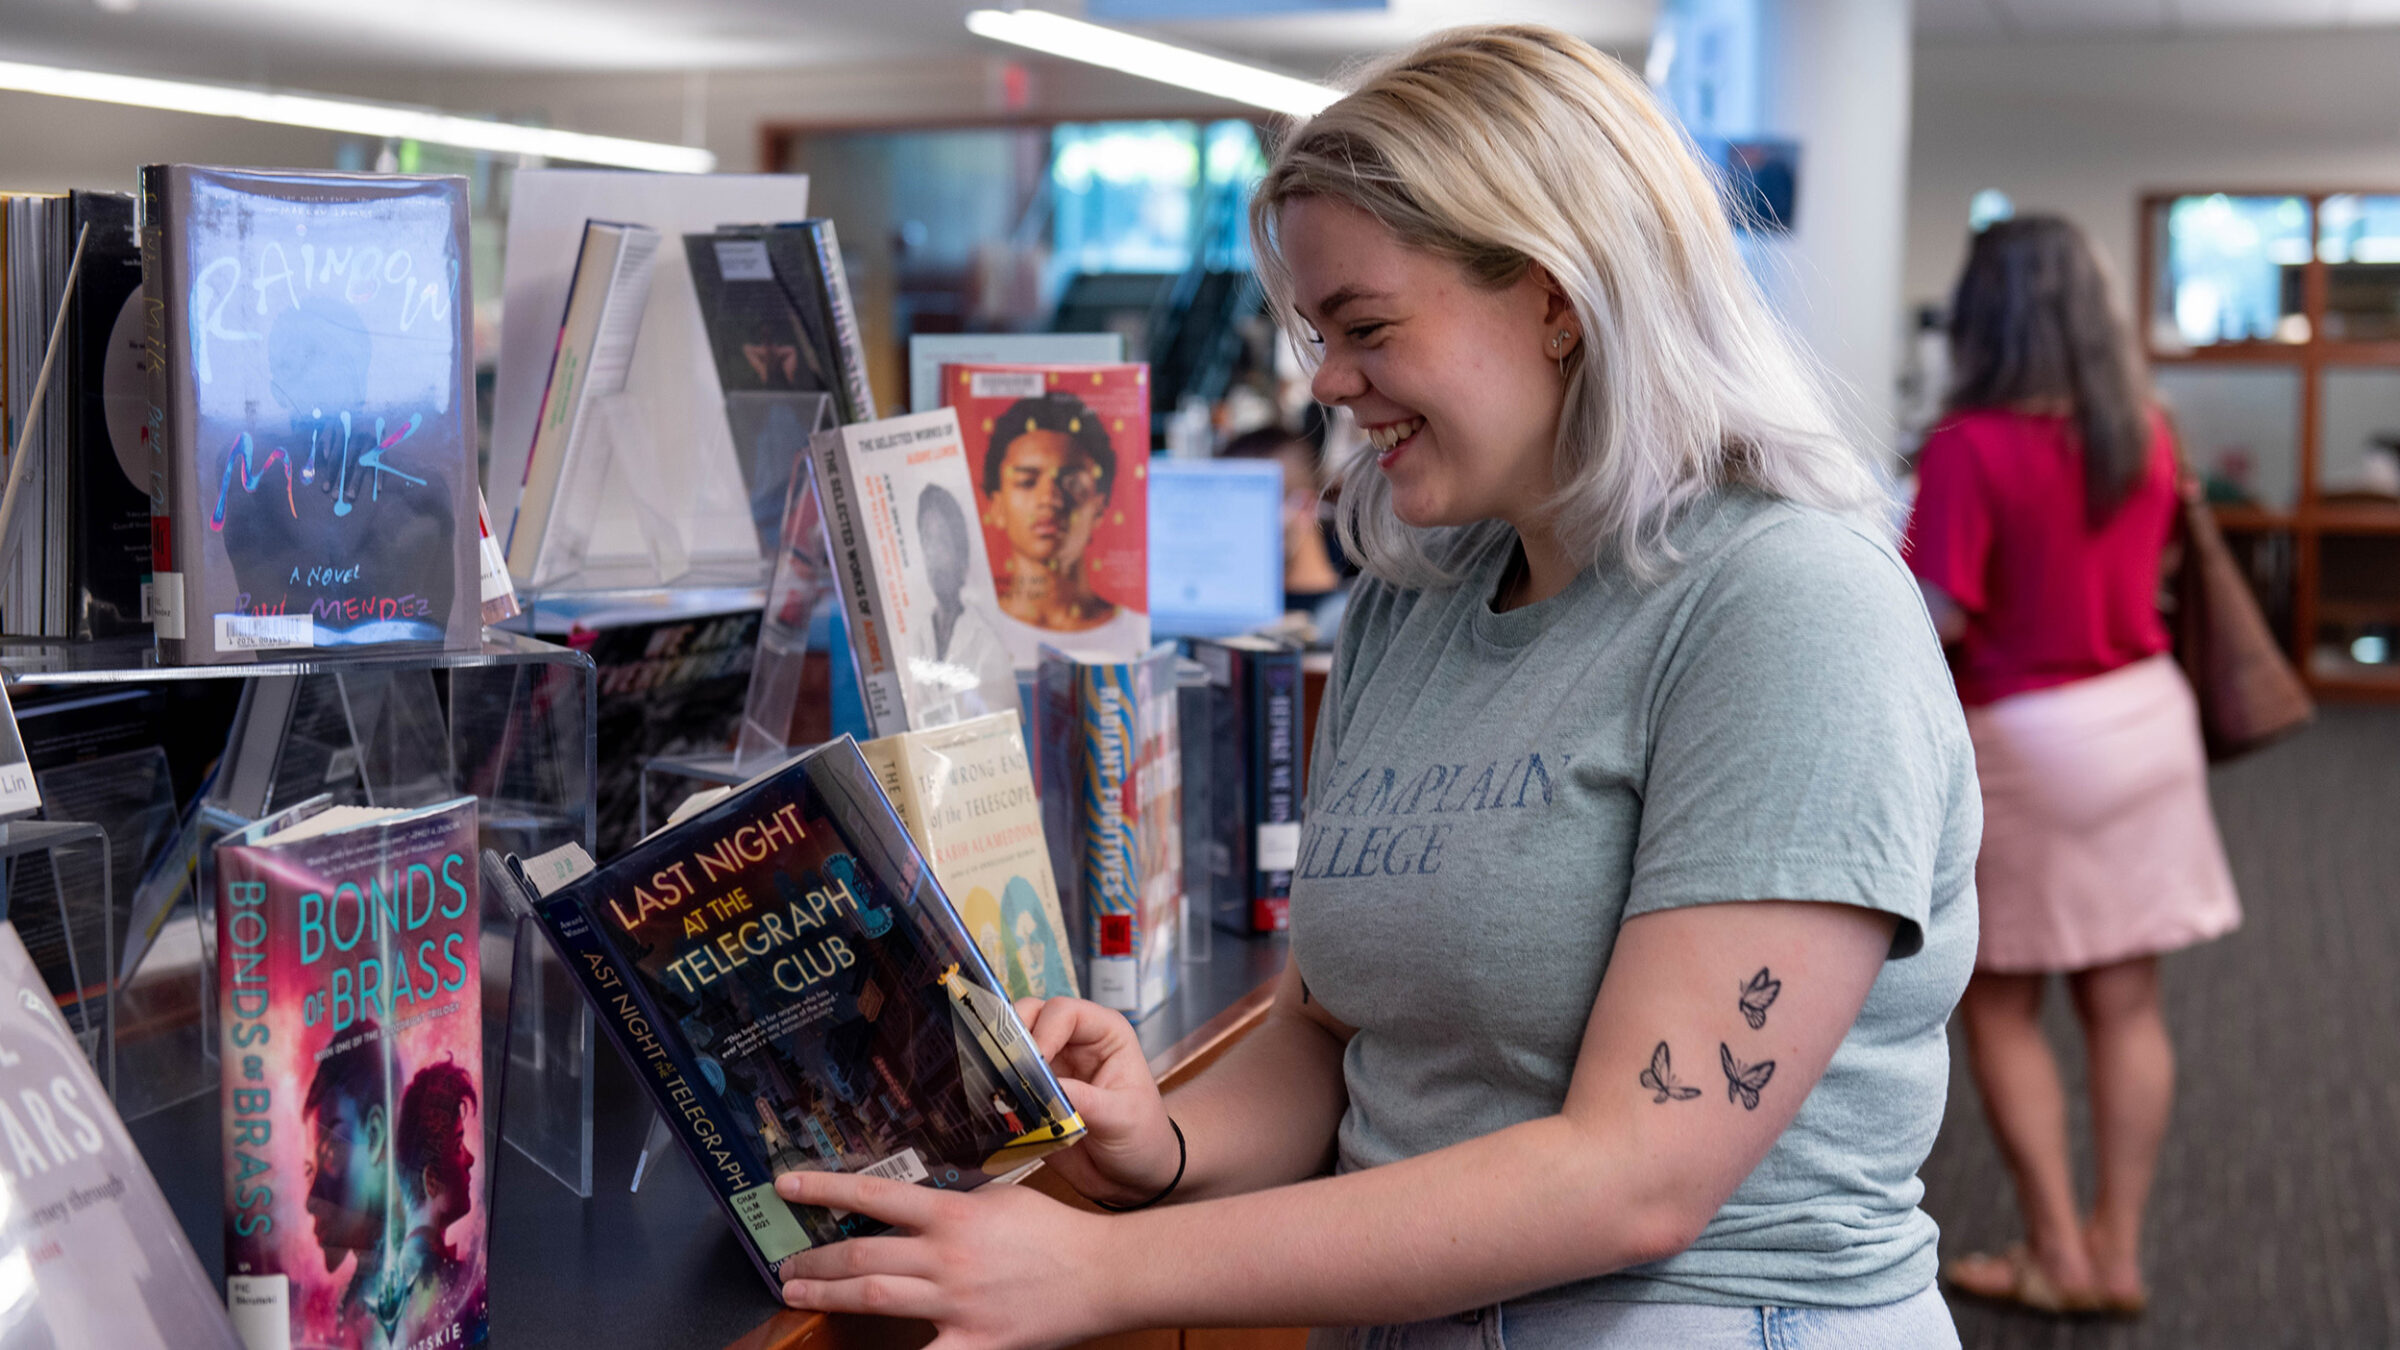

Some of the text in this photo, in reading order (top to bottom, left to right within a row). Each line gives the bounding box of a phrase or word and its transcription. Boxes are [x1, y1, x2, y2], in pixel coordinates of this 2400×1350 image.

[824, 448, 840, 476] THE
[831, 475, 855, 547] SELECTED
[290, 566, 300, 585] A
[847, 546, 867, 598] WORKS
[309, 594, 432, 621] MENDEZ
[858, 598, 872, 617] OF
[2, 775, 27, 794] Lin
[883, 760, 900, 794] THE
[950, 759, 995, 787] WRONG
[1000, 753, 1026, 774] END
[930, 808, 943, 829] of
[946, 803, 962, 825] the
[966, 784, 1032, 818] TELESCOPE
[1100, 686, 1124, 898] RADIANT FUGITIVES
[609, 803, 806, 931] LAST NIGHT
[300, 853, 467, 965] BONDS
[559, 914, 584, 929] Award
[682, 887, 753, 939] AT THE
[563, 925, 589, 938] Winner
[666, 877, 859, 993] TELEGRAPH
[772, 936, 856, 992] CLUB
[303, 932, 467, 1032] OF BRASS
[228, 881, 272, 1237] BONDS OF BRASS
[580, 949, 622, 989] AST
[611, 993, 668, 1060] NIGHT
[666, 1074, 751, 1191] TELEGRAPH
[933, 1168, 960, 1189] LO
[736, 1191, 757, 1205] CHAP
[747, 1211, 764, 1223] Last
[753, 1219, 771, 1231] 2021
[409, 1322, 462, 1350] TSKIE
